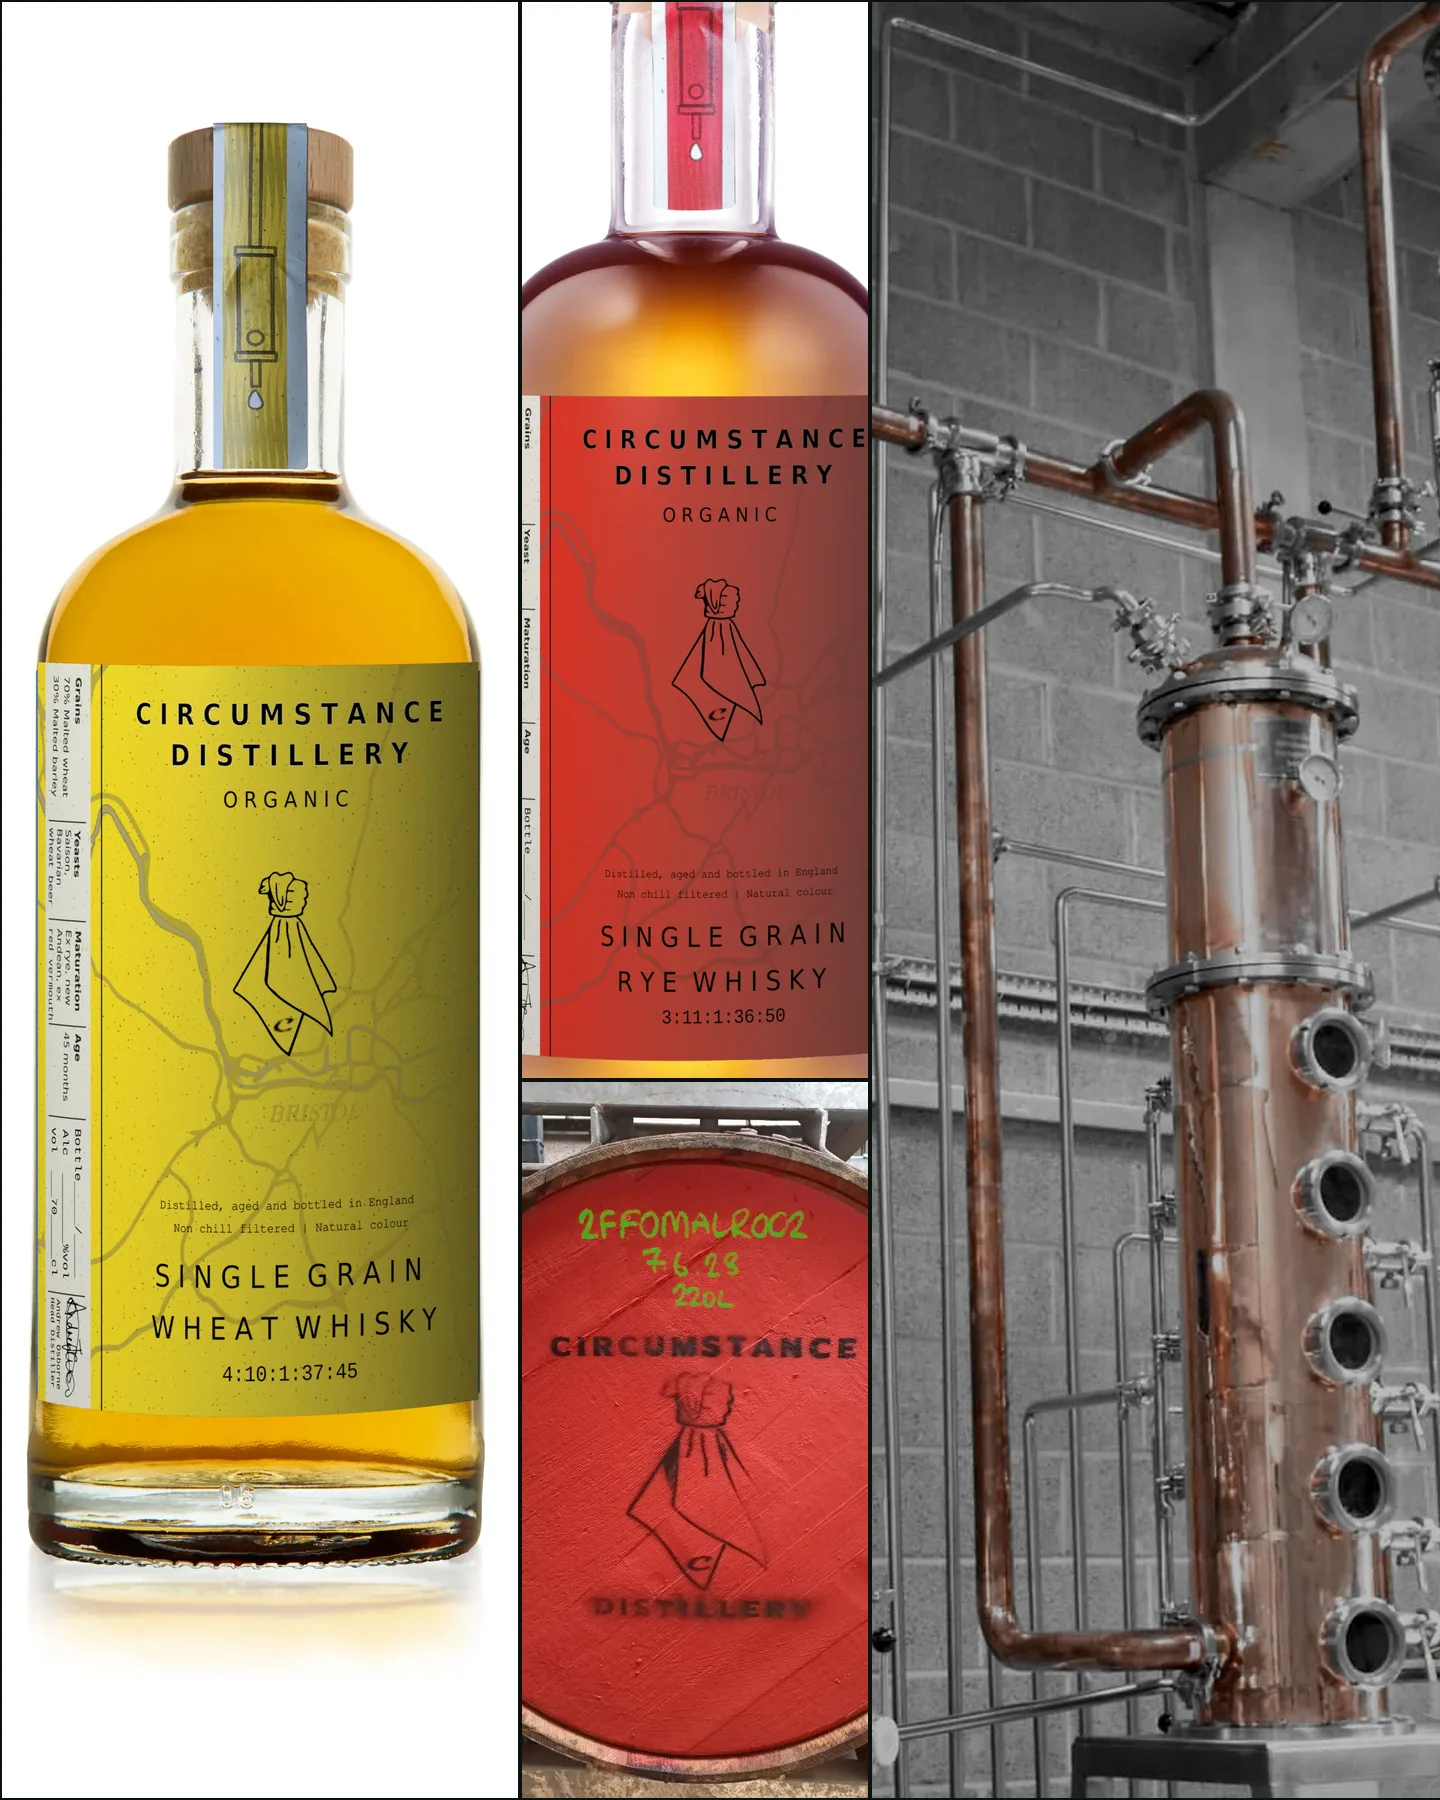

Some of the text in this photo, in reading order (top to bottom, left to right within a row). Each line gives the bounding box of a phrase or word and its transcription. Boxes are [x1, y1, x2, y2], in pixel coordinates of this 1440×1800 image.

[523, 407, 532, 449] Grains
[583, 428, 865, 449] CIRCUMSTANCE
[615, 465, 833, 485] DISTILLERY
[663, 506, 778, 523] ORGANIC
[52, 677, 60, 704] 30%
[63, 677, 71, 705] 70%
[74, 677, 83, 724] Grains
[136, 700, 444, 725] CIRCUMSTANCE
[62, 709, 70, 753] Malted
[523, 728, 531, 755] Age
[172, 742, 409, 766] DISTILLERY
[50, 756, 59, 798] barley
[223, 790, 349, 809] ORGANIC
[524, 807, 532, 855] Bottle
[63, 829, 72, 876] Saison,
[73, 831, 82, 878] Yeasts
[605, 866, 839, 881] Distilled, aged and bottled in England
[617, 889, 635, 899] Non
[641, 889, 671, 899] chill
[677, 889, 728, 899] filtered
[746, 888, 790, 898] Natural
[796, 887, 834, 897] colour
[65, 930, 72, 946] Ex
[601, 922, 846, 948] SINGLE GRAIN
[63, 950, 72, 974] rye,
[74, 931, 82, 1012] Maturation
[618, 968, 827, 993] RYE WHISKY
[56, 986, 62, 1002] ex
[662, 1007, 786, 1025] 3:11:1:36:50
[63, 1032, 70, 1048] 45
[73, 1034, 82, 1062] Age
[74, 1129, 83, 1182] Bottle
[51, 1199, 58, 1215] 70
[160, 1195, 415, 1213] Distilled, aged and bottled in England
[173, 1223, 193, 1233] Non
[199, 1223, 233, 1234] chill
[240, 1222, 295, 1234] filtered
[315, 1221, 363, 1233] Natural
[370, 1219, 409, 1231] colour
[51, 1259, 59, 1275] cl
[62, 1243, 70, 1279] %vol
[155, 1257, 423, 1290] SINGLE GRAIN
[672, 1282, 736, 1309] 220L
[152, 1306, 437, 1341] WHEAT WHISKY
[551, 1335, 858, 1359] CIRCUMSTANCE
[222, 1362, 358, 1383] 4:10:1:37:45
[592, 1596, 811, 1619] DISTILLERY
